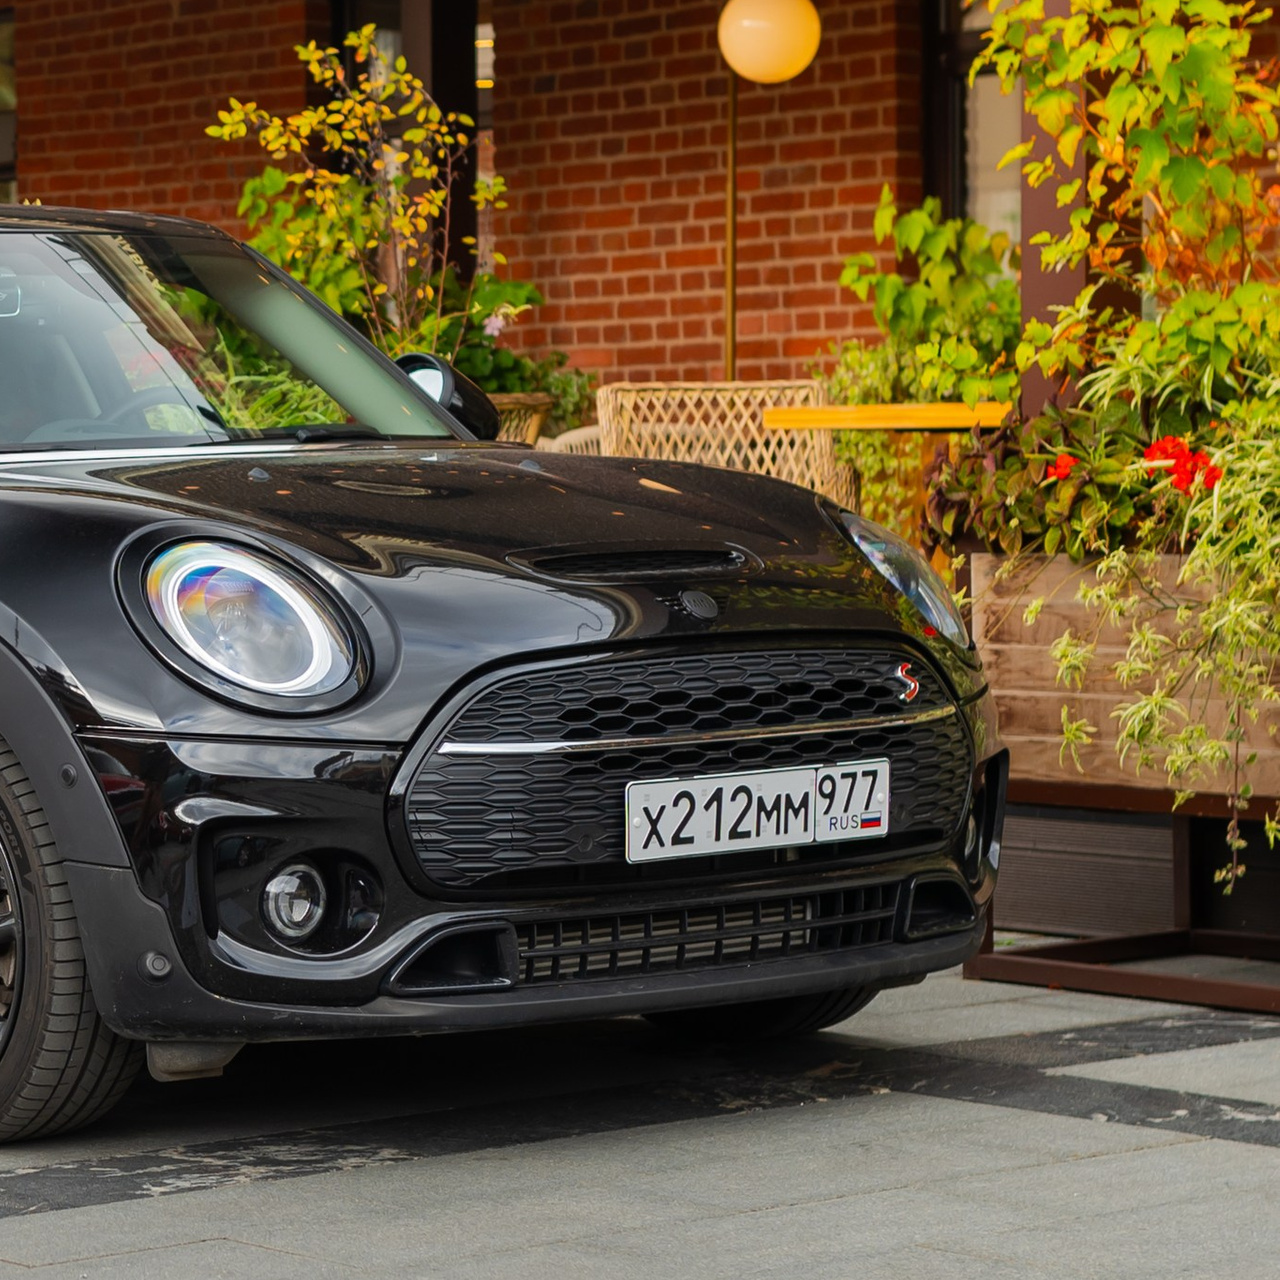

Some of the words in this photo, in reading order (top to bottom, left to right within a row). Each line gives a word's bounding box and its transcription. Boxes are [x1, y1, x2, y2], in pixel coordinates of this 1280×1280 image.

[897, 663, 920, 703] S
[818, 769, 879, 815] 977
[642, 784, 810, 850] Х212ММ
[829, 815, 859, 832] RUS
